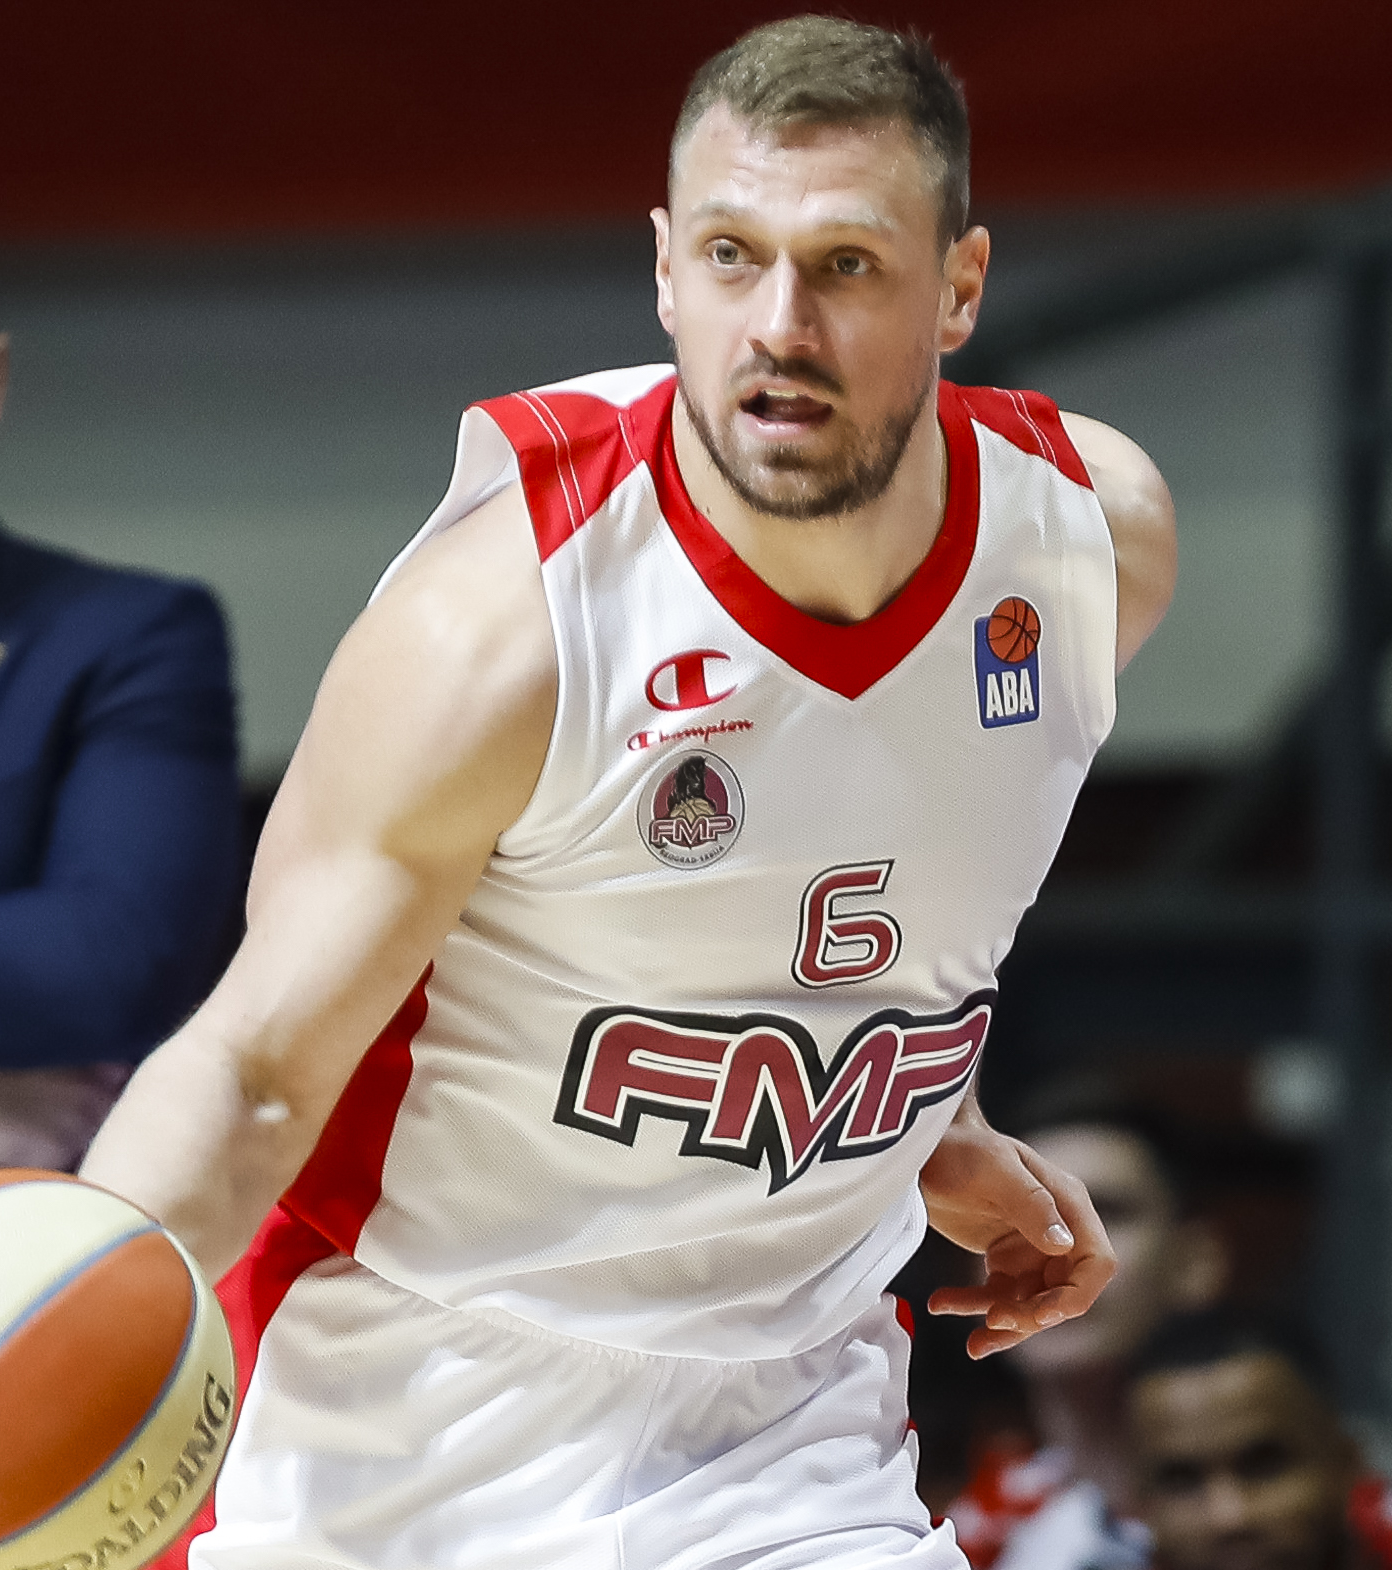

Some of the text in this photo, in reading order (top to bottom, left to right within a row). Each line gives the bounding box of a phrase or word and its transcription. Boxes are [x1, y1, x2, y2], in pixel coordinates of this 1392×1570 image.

[986, 668, 1035, 718] ABA
[649, 814, 736, 849] FMP
[791, 858, 903, 989] 6
[552, 992, 992, 1198] FMP
